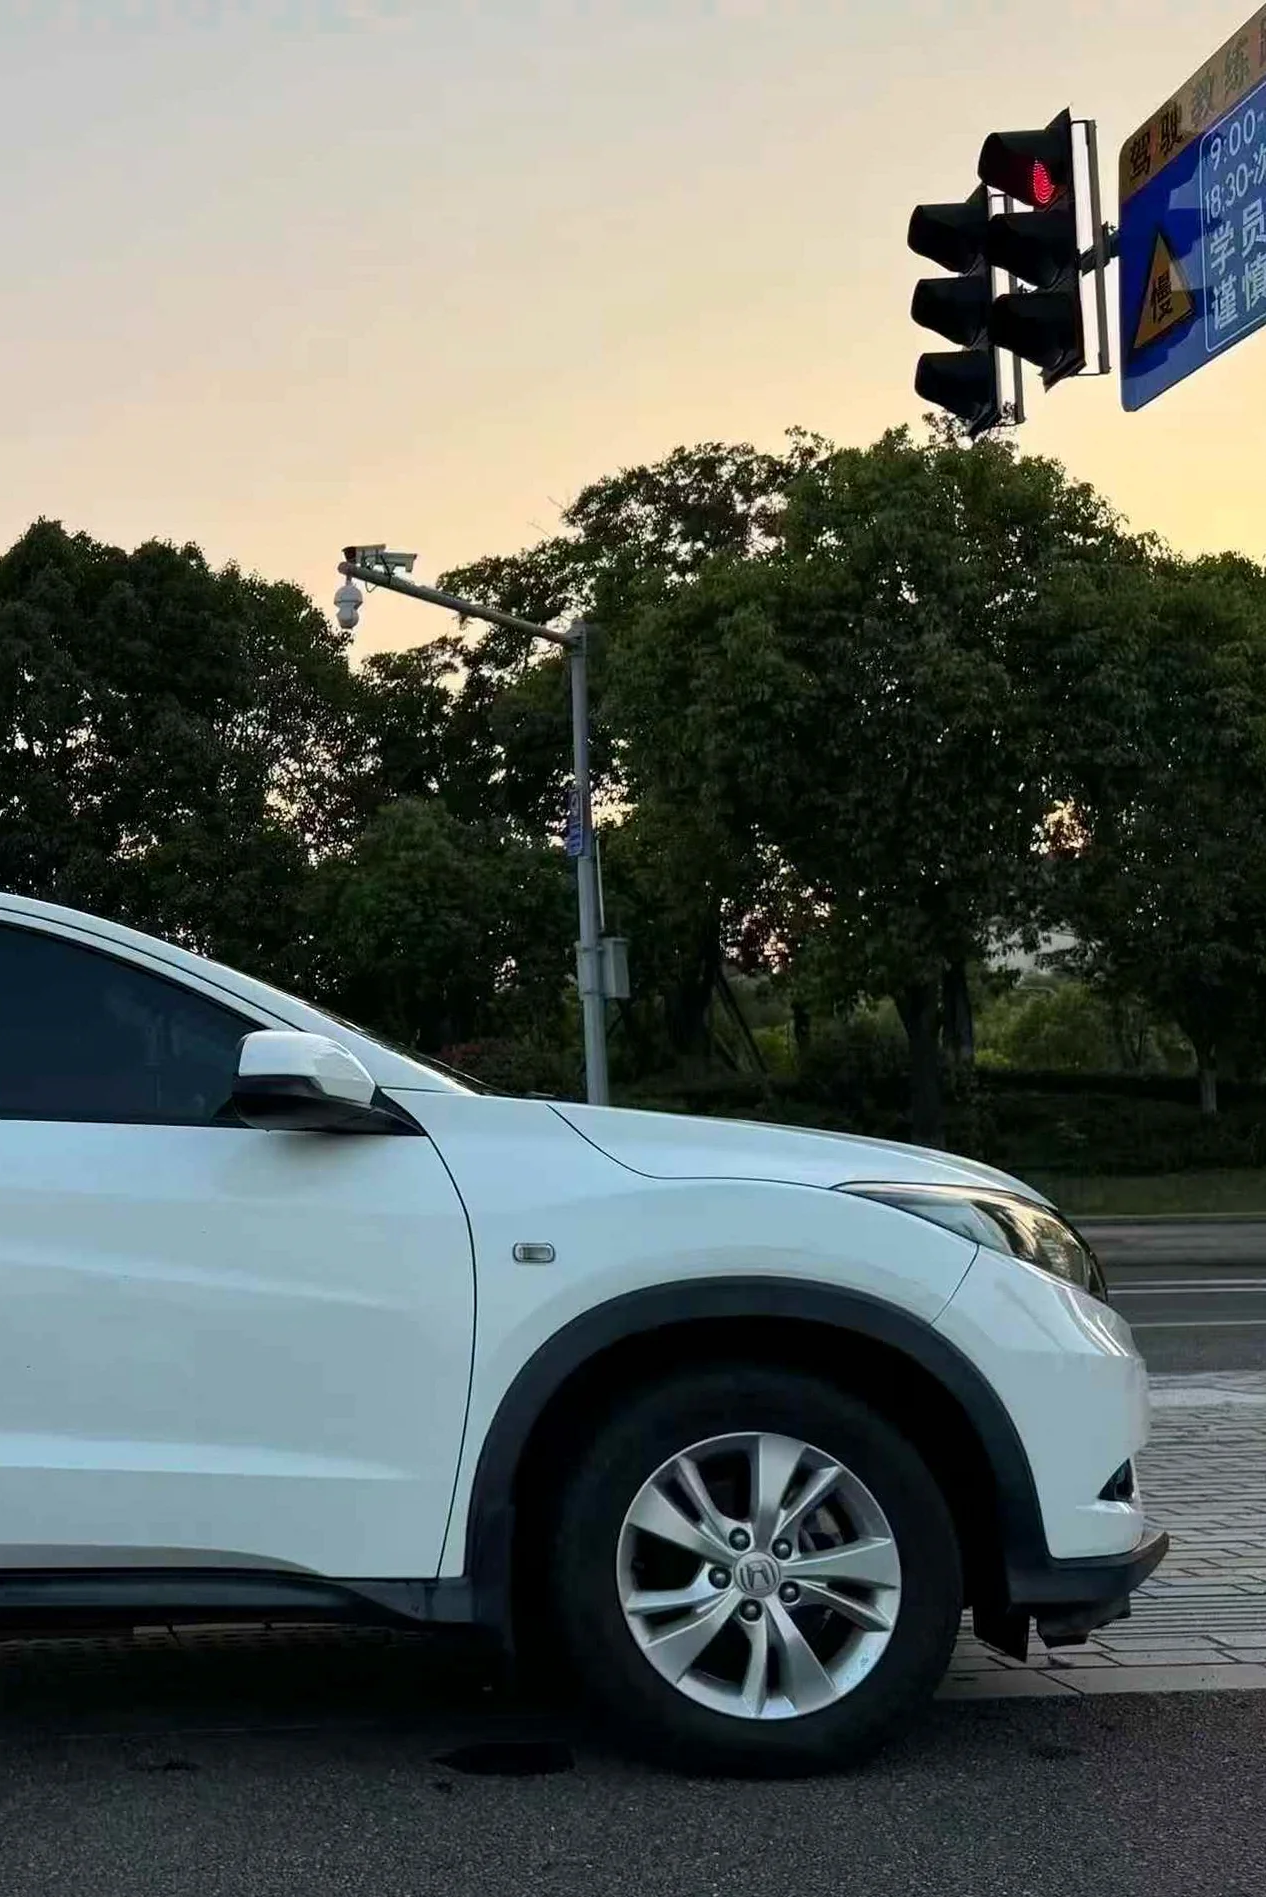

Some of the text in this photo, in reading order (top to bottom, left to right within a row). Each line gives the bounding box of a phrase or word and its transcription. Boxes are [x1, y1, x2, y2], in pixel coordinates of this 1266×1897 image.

[1130, 18, 1266, 181] 驾驶教练
[1211, 198, 1266, 275] 学员
